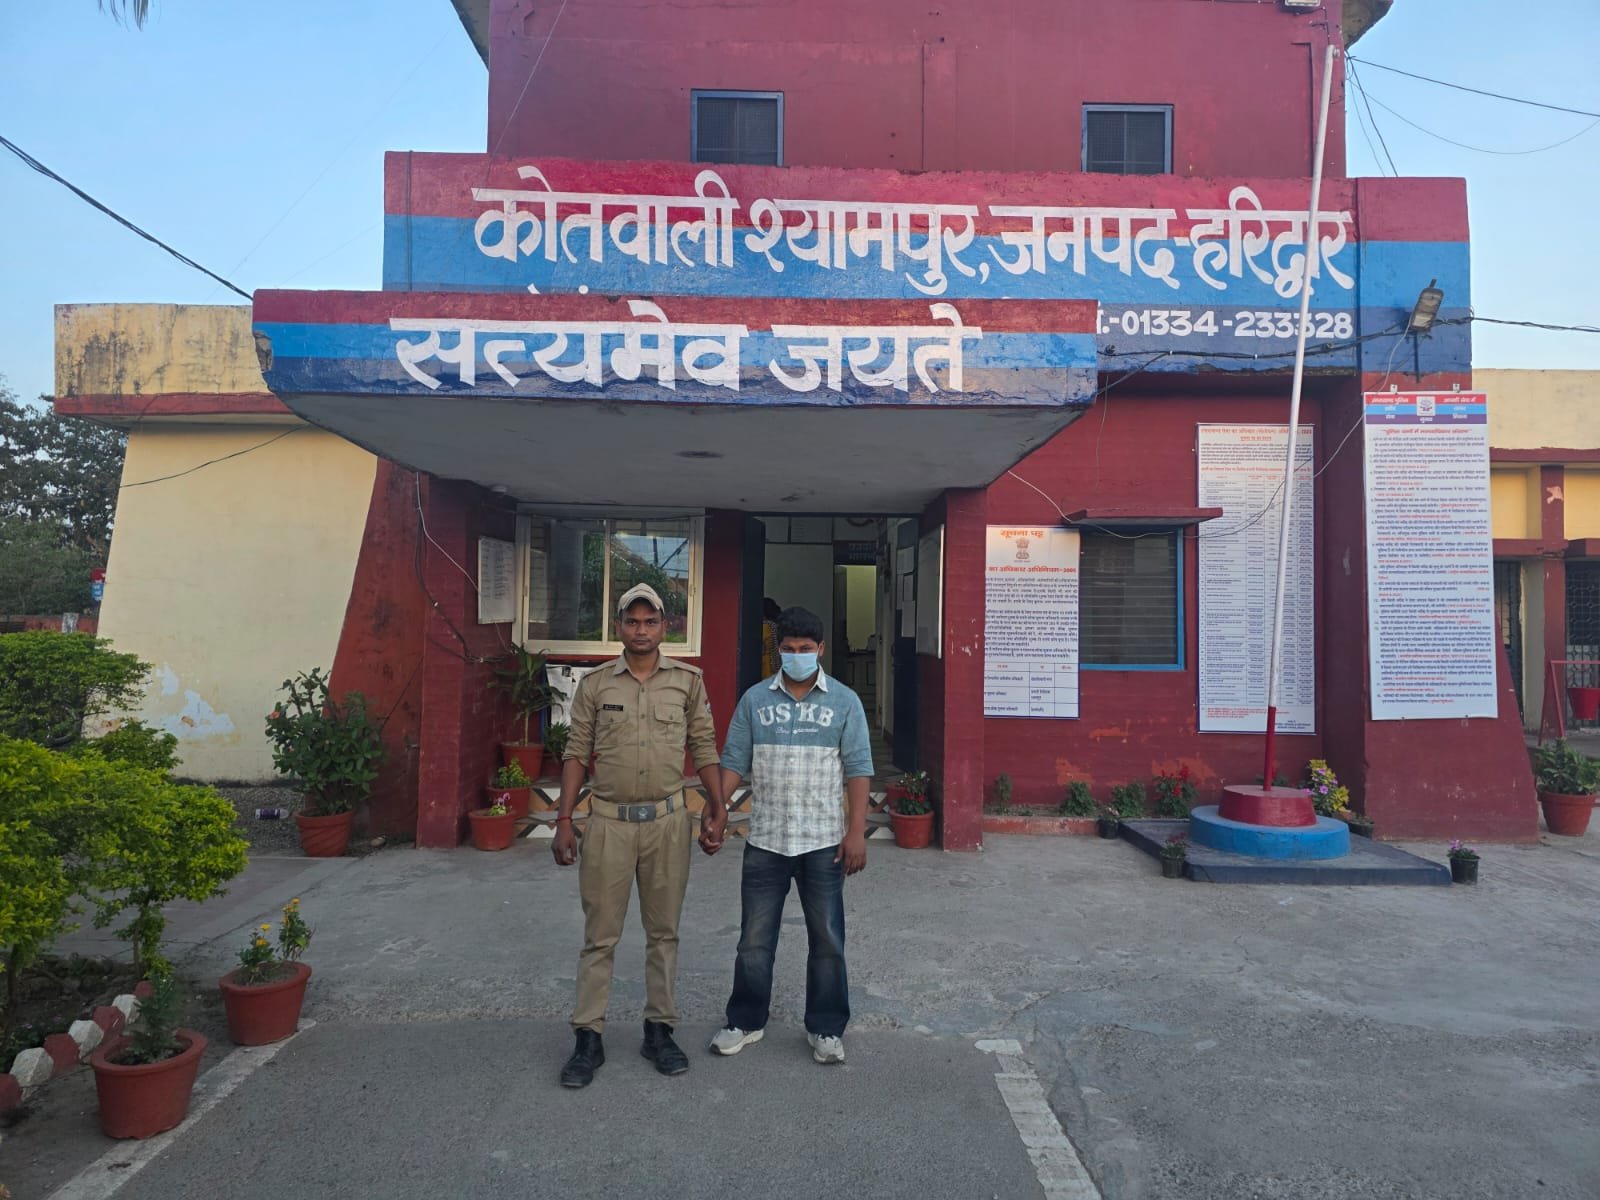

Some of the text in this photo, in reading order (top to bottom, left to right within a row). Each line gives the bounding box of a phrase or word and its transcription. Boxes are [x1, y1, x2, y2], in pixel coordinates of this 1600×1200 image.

[471, 166, 740, 268] कोतवाली
[389, 300, 983, 393] सत्यमेव जयते
